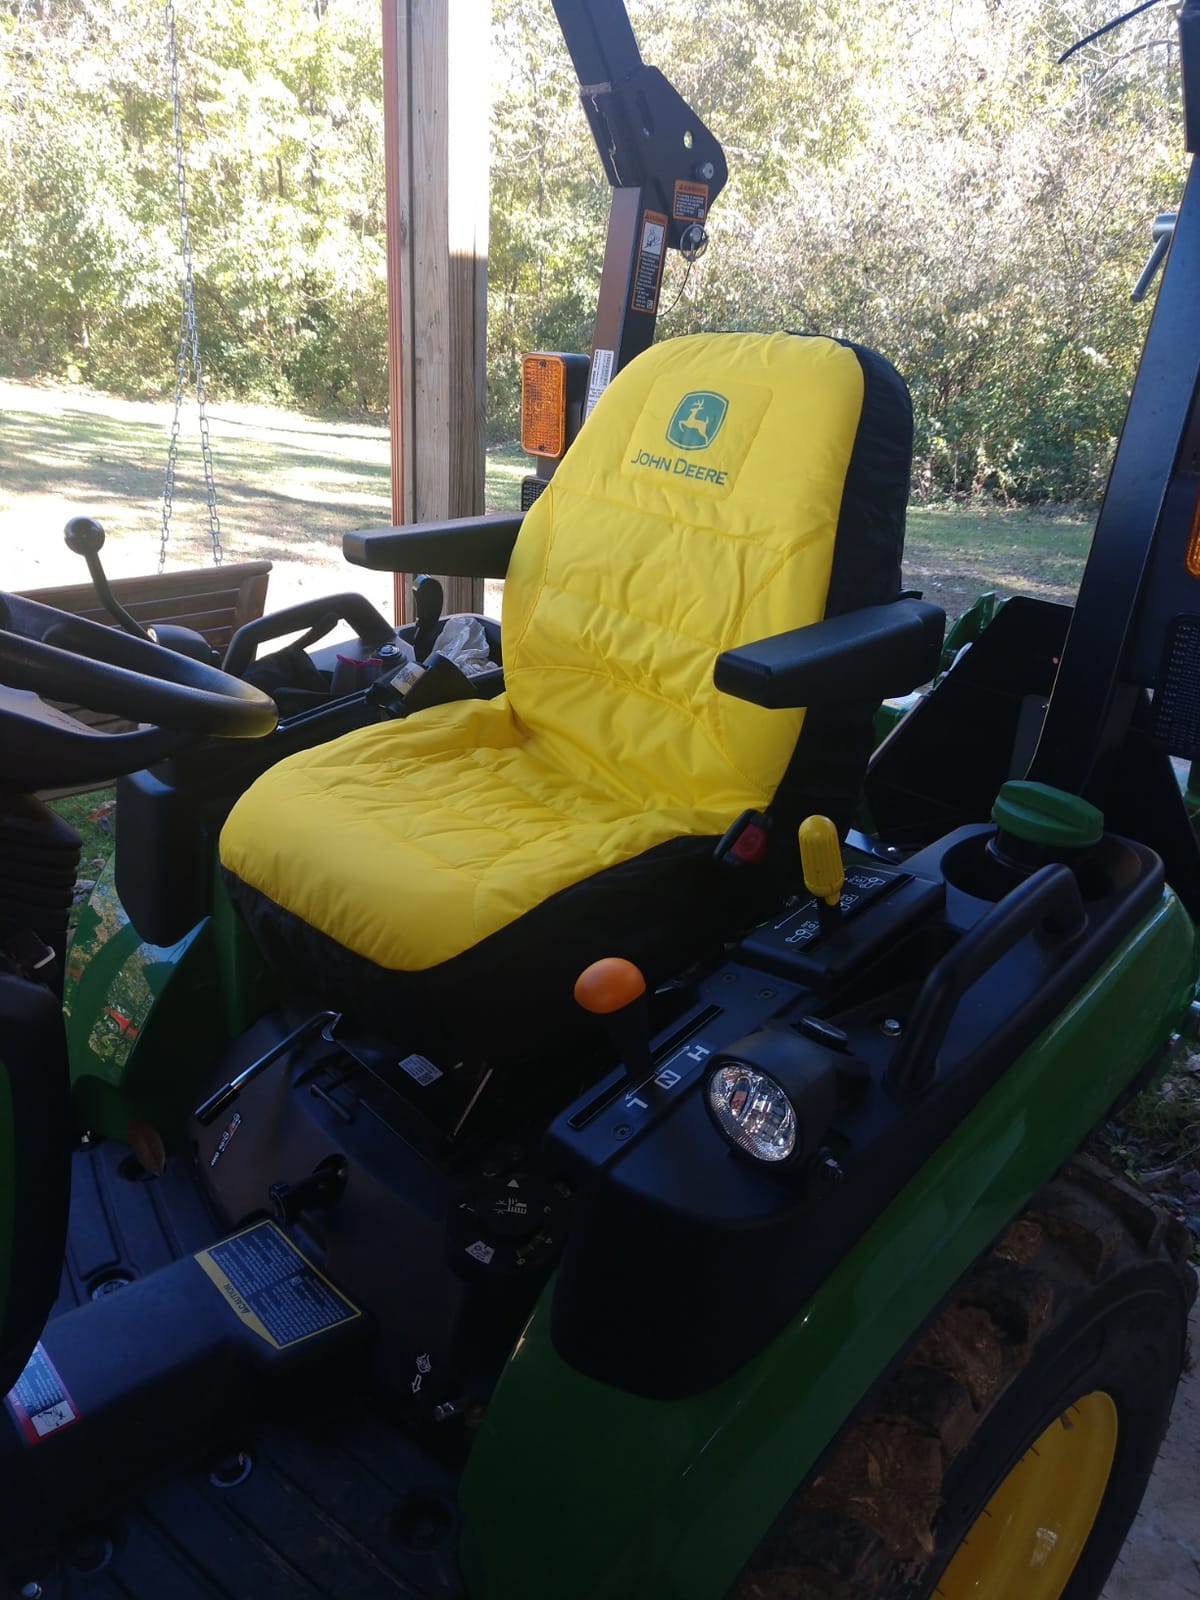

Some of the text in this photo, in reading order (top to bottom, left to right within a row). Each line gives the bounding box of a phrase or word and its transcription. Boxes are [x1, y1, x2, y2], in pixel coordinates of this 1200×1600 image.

[631, 448, 728, 486] JOHN DEERE
[687, 1045, 710, 1061] H
[657, 1071, 680, 1088] N
[626, 1098, 648, 1109] L
[223, 1282, 247, 1311] CAUTION
